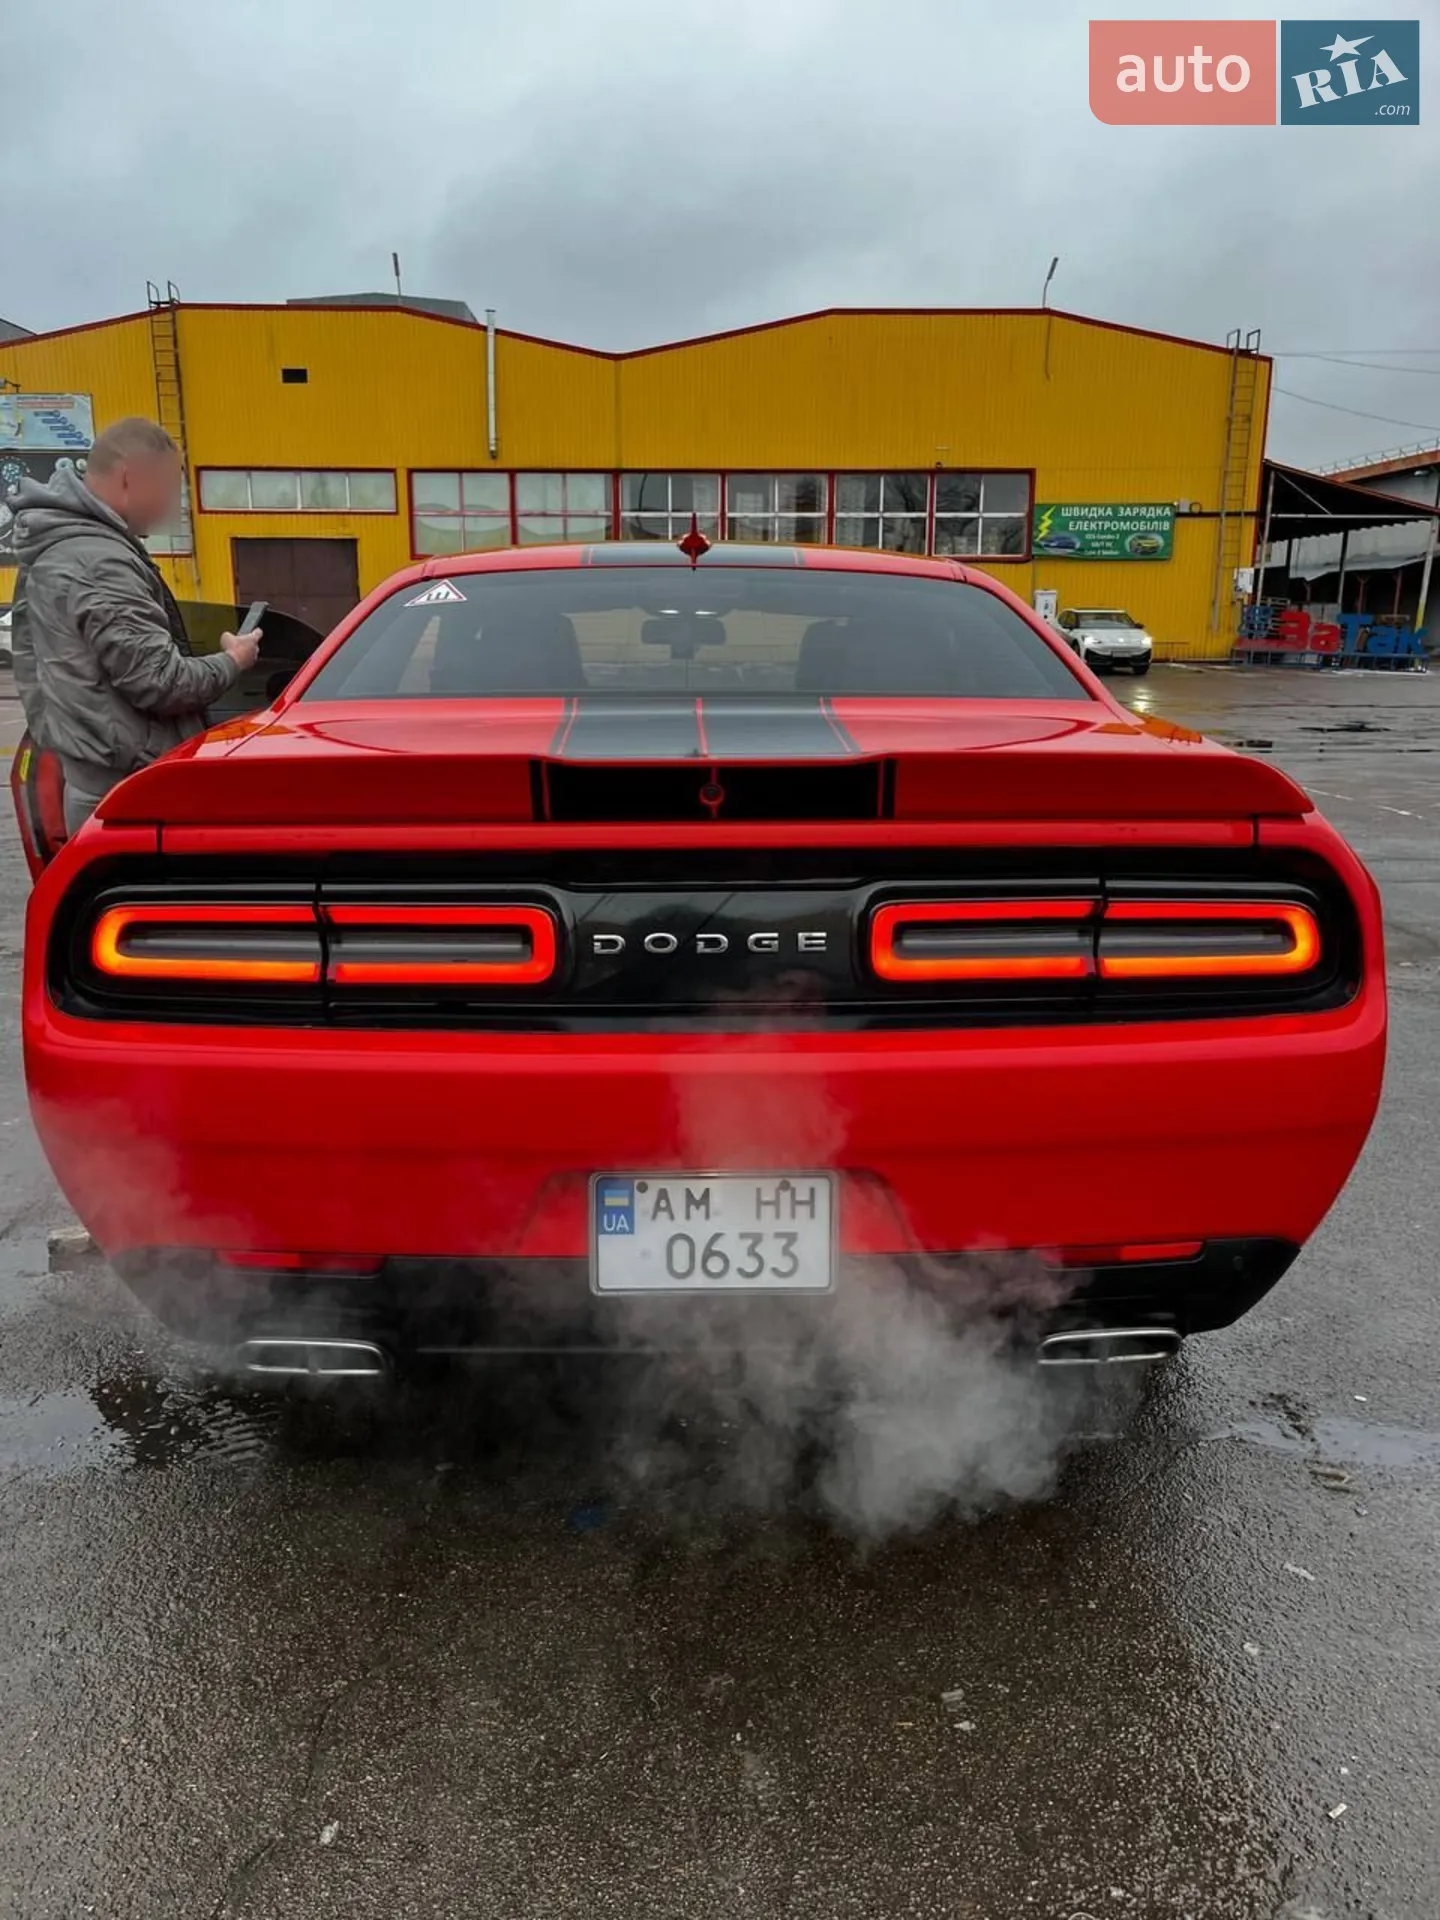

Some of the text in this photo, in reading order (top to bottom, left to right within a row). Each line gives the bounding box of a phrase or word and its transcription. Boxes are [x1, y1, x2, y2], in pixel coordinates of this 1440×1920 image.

[1061, 506, 1171, 518] ШВИДКА ЗАРЯДКА
[1068, 520, 1170, 531] ЕЛЕКТРОМОБІЛІВ
[592, 931, 828, 954] DODGE
[651, 1186, 816, 1221] AM HH
[603, 1213, 630, 1232] UA
[665, 1231, 800, 1281] 0633
